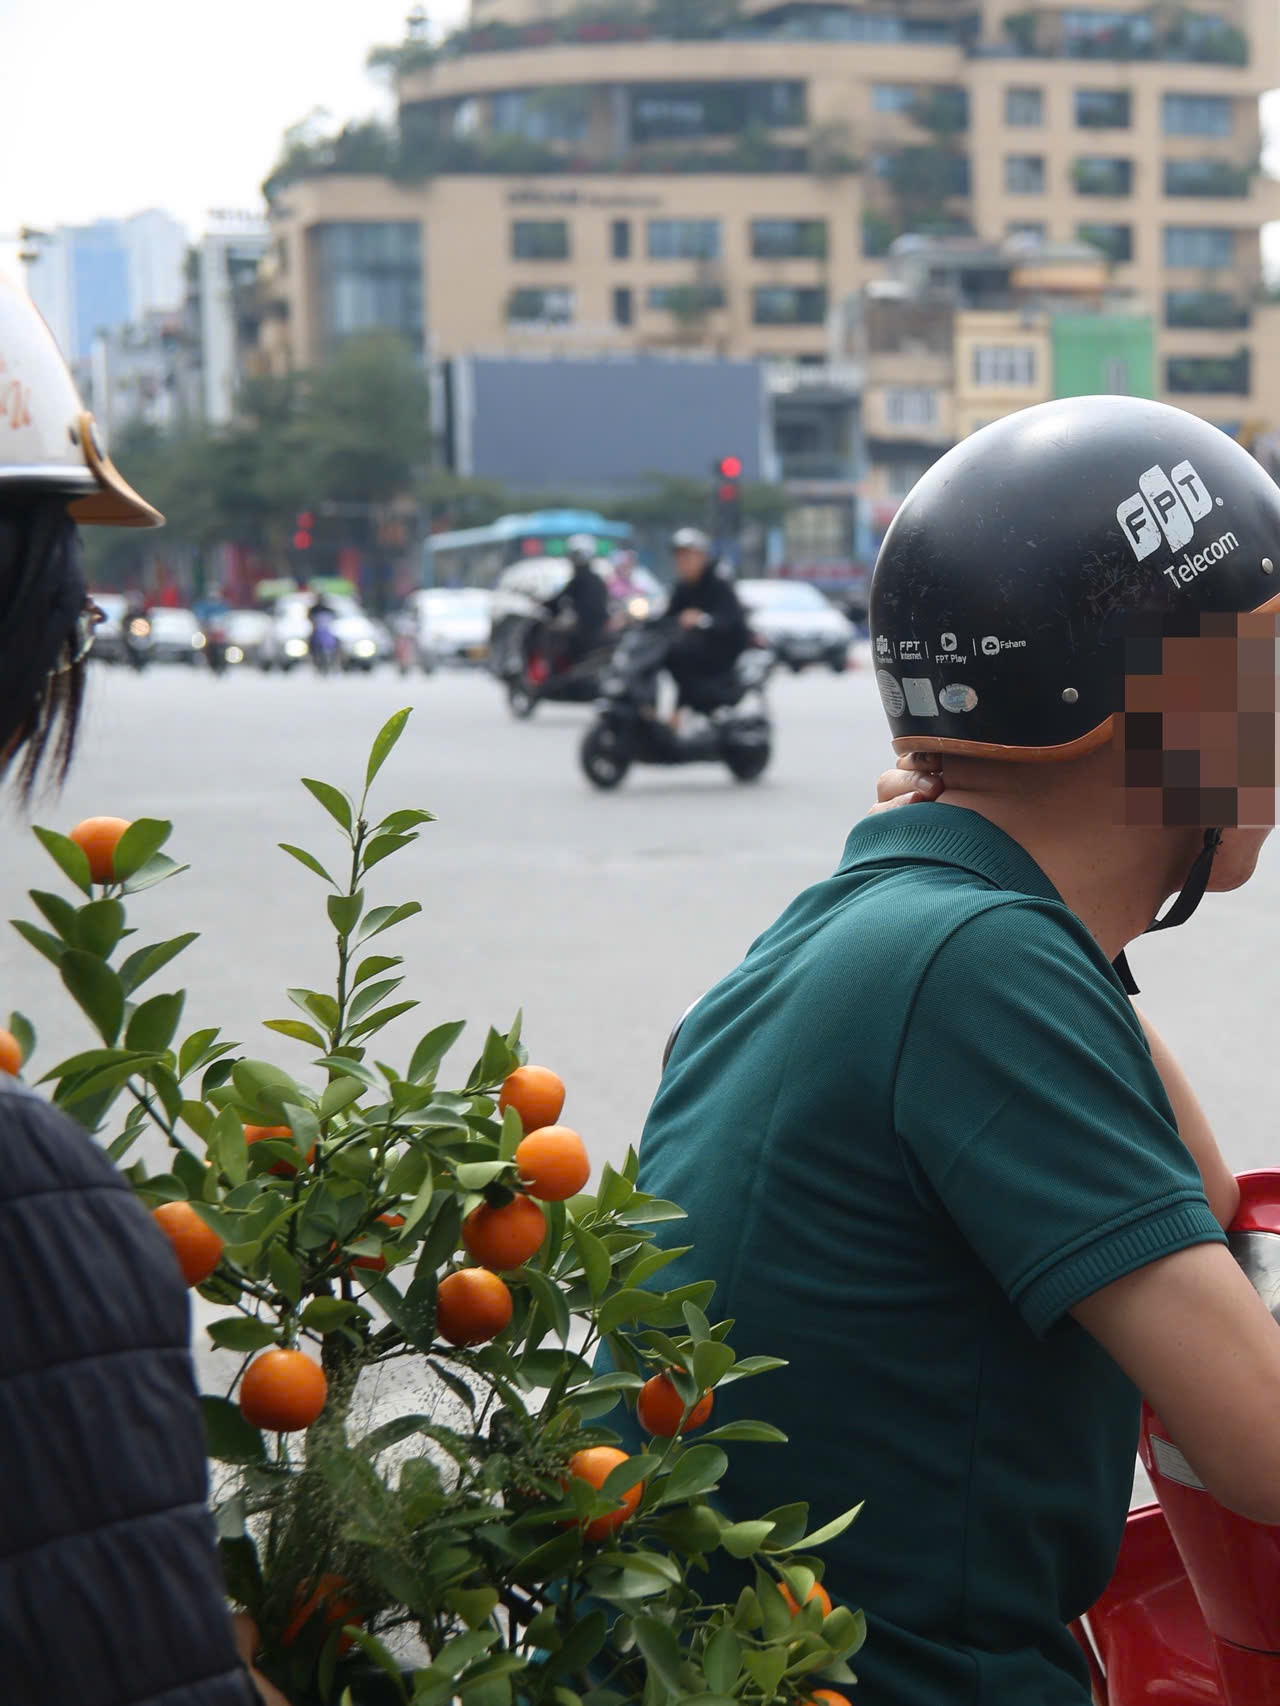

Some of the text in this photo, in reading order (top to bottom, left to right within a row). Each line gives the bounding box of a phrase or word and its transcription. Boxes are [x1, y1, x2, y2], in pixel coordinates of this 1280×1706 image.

[1118, 462, 1210, 559] FPT
[1163, 531, 1240, 589] Telecom
[900, 641, 920, 651] FPT
[1000, 639, 1026, 649] Fshare
[935, 653, 967, 665] FPT Play
